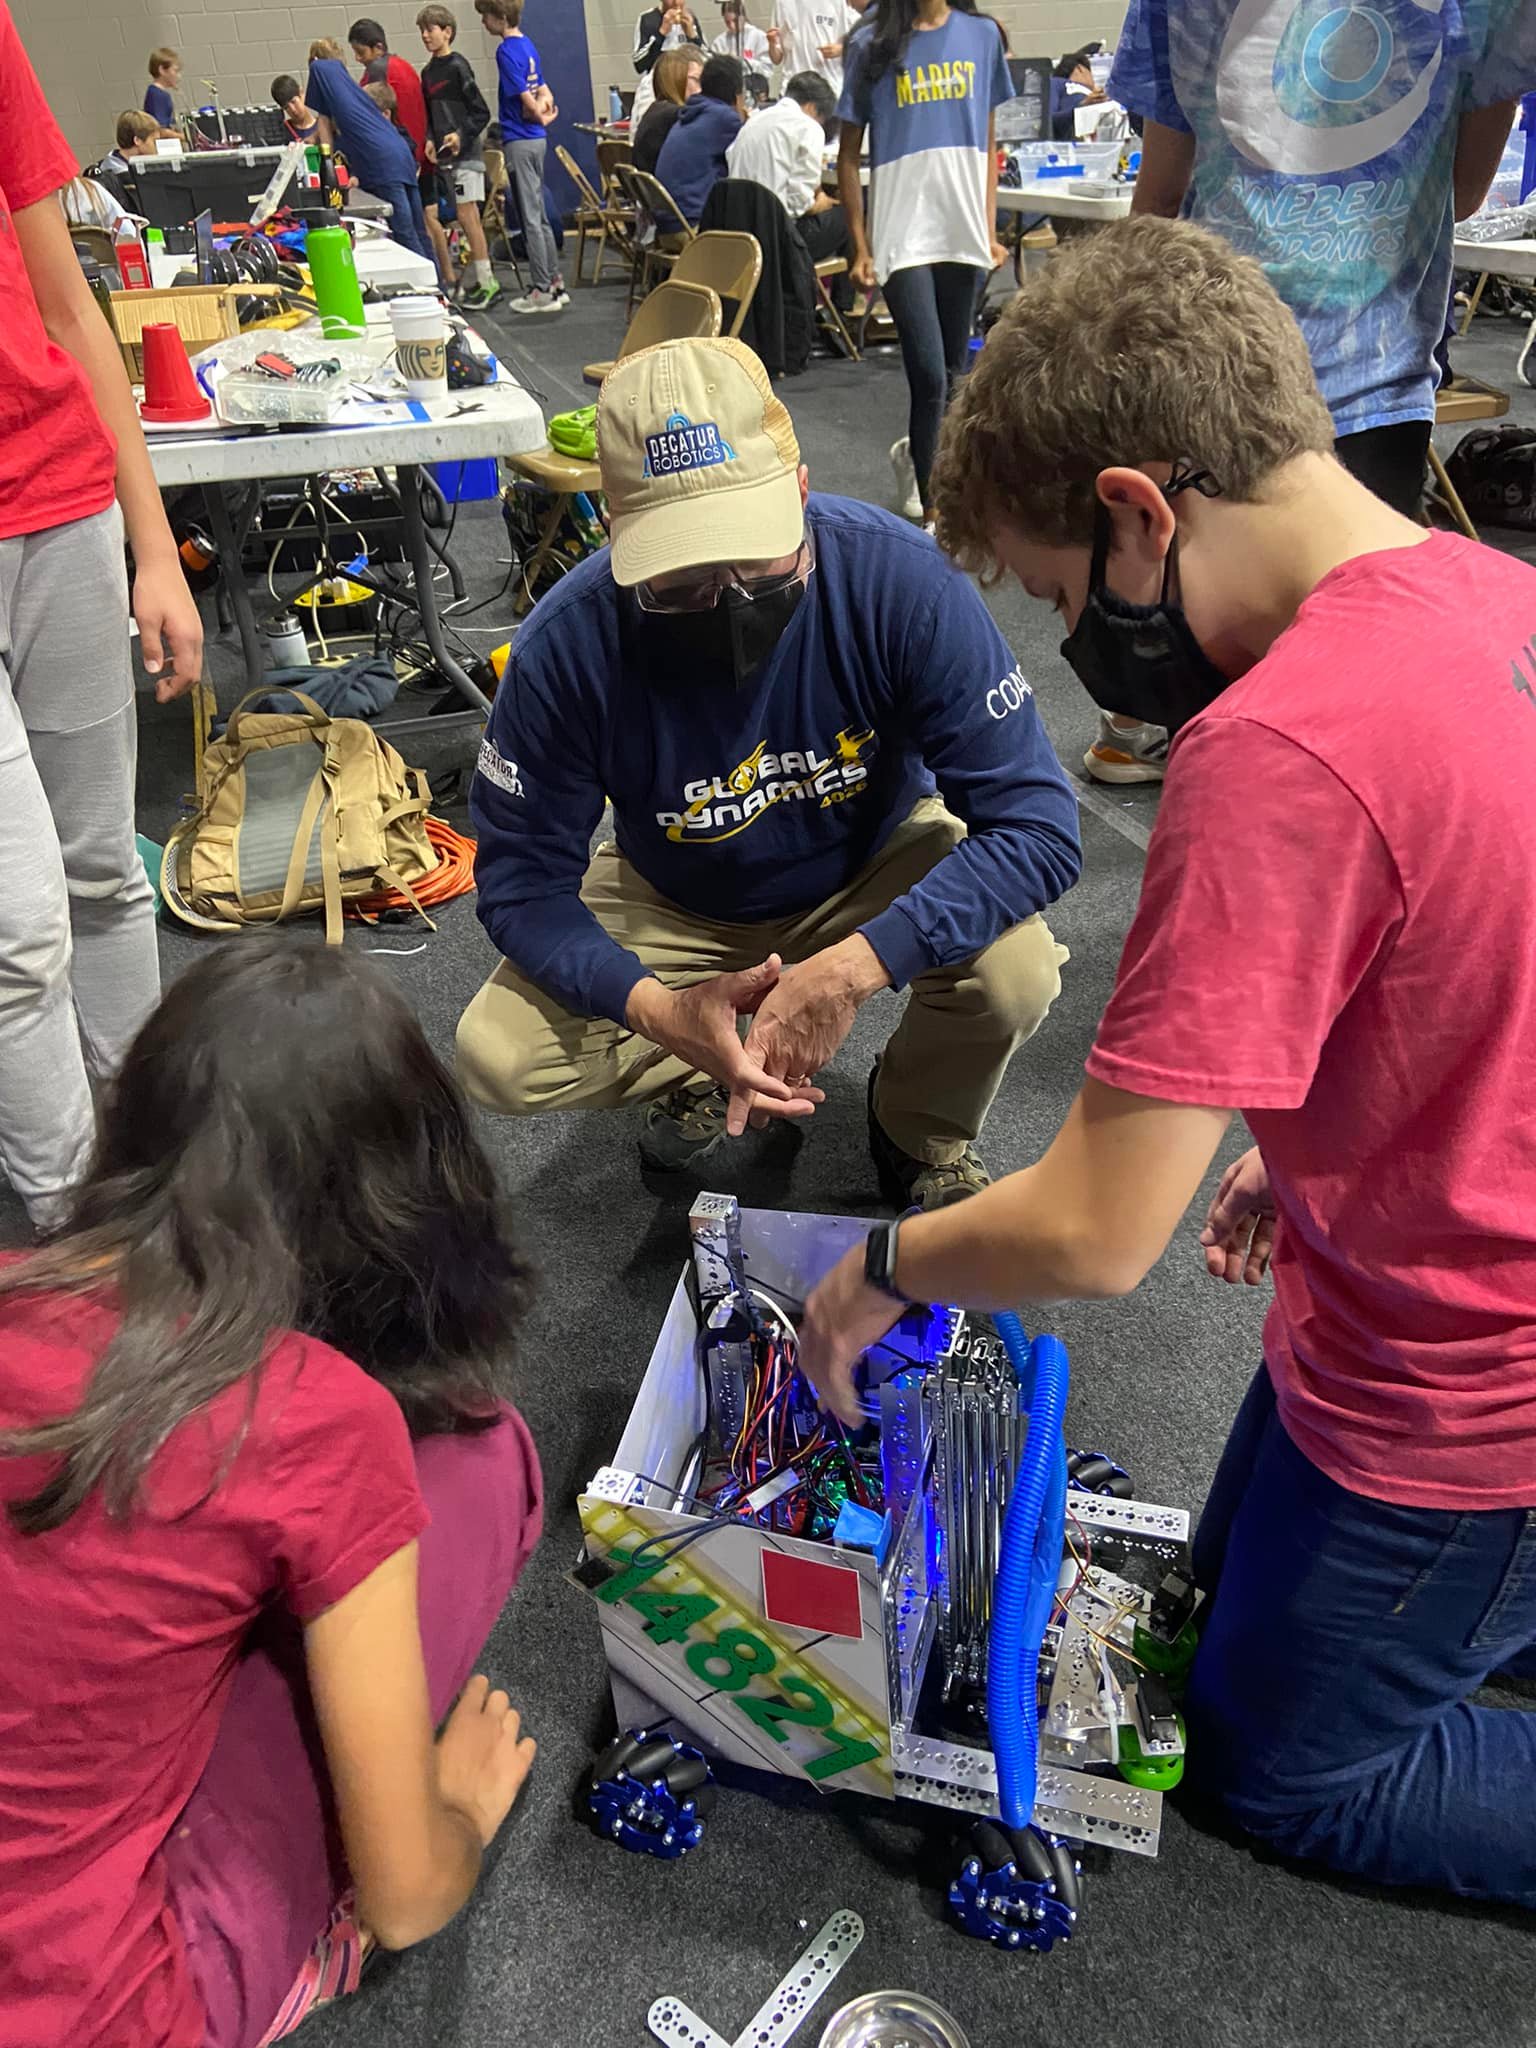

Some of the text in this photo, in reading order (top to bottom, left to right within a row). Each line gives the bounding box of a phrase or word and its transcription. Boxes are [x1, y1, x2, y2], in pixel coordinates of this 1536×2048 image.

[896, 60, 975, 108] MARIST
[649, 426, 717, 458] DECATUR
[653, 446, 722, 473] ROBOTICS
[655, 763, 869, 830] DYNAMICS
[684, 749, 830, 804] GLOBAL
[594, 1548, 882, 1782] 14821
